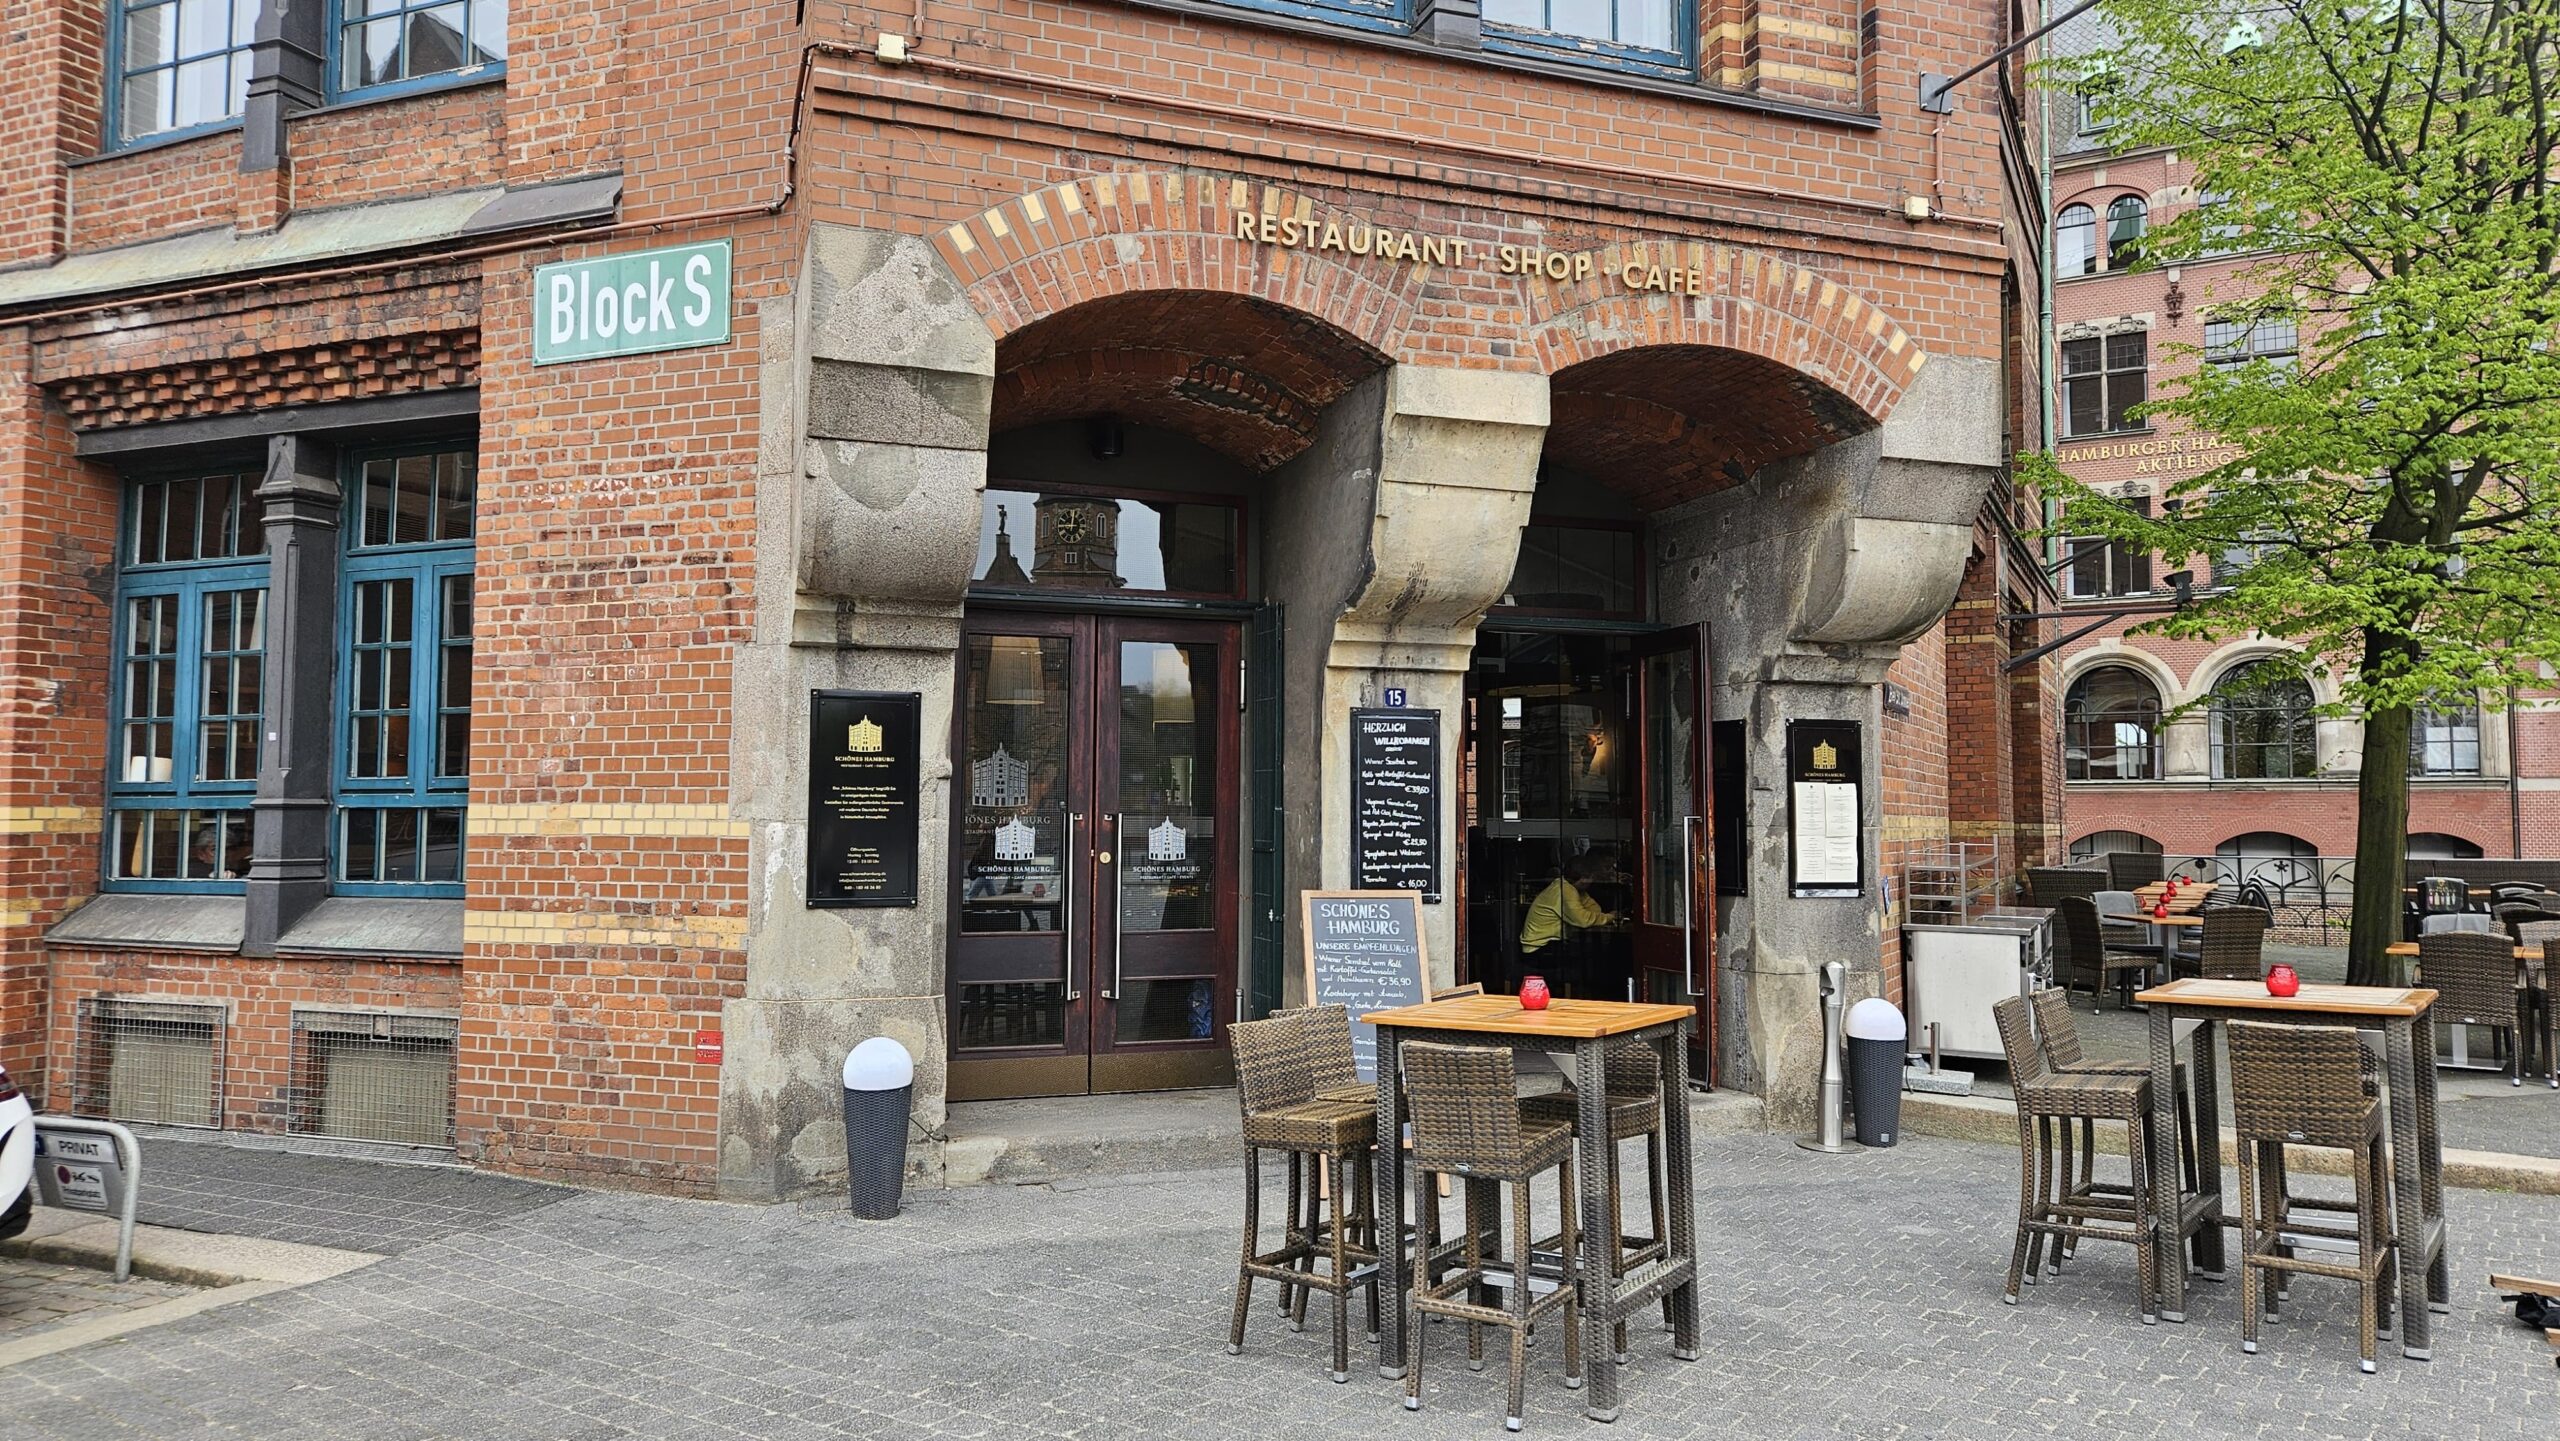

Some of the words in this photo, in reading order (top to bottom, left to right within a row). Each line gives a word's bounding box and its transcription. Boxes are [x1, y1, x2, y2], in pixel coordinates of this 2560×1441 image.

[1237, 212, 1467, 266] RESTAURANT
[1500, 245, 1592, 281] SHOP
[1622, 262, 1701, 296] CAFÉ
[2058, 438, 2181, 463] HAMBURGER
[2136, 449, 2248, 474] AKTIENGE
[1388, 690, 1402, 705] 15
[1363, 722, 1406, 734] HERZLICH
[1374, 737, 1430, 746] WILLKOMMEN
[978, 864, 1012, 873] SCHÖNES
[1013, 865, 1051, 873] HAMBURG
[1132, 865, 1165, 873] SCHÖNES
[1166, 865, 1201, 873] HAMBURG
[1320, 899, 1391, 920] SCHÖNES
[1326, 920, 1400, 935] HAMBURG
[1315, 942, 1351, 951] UNSERE
[1353, 942, 1417, 954] EMPFEHLUNGEN
[58, 1140, 98, 1157] PRIVAT
